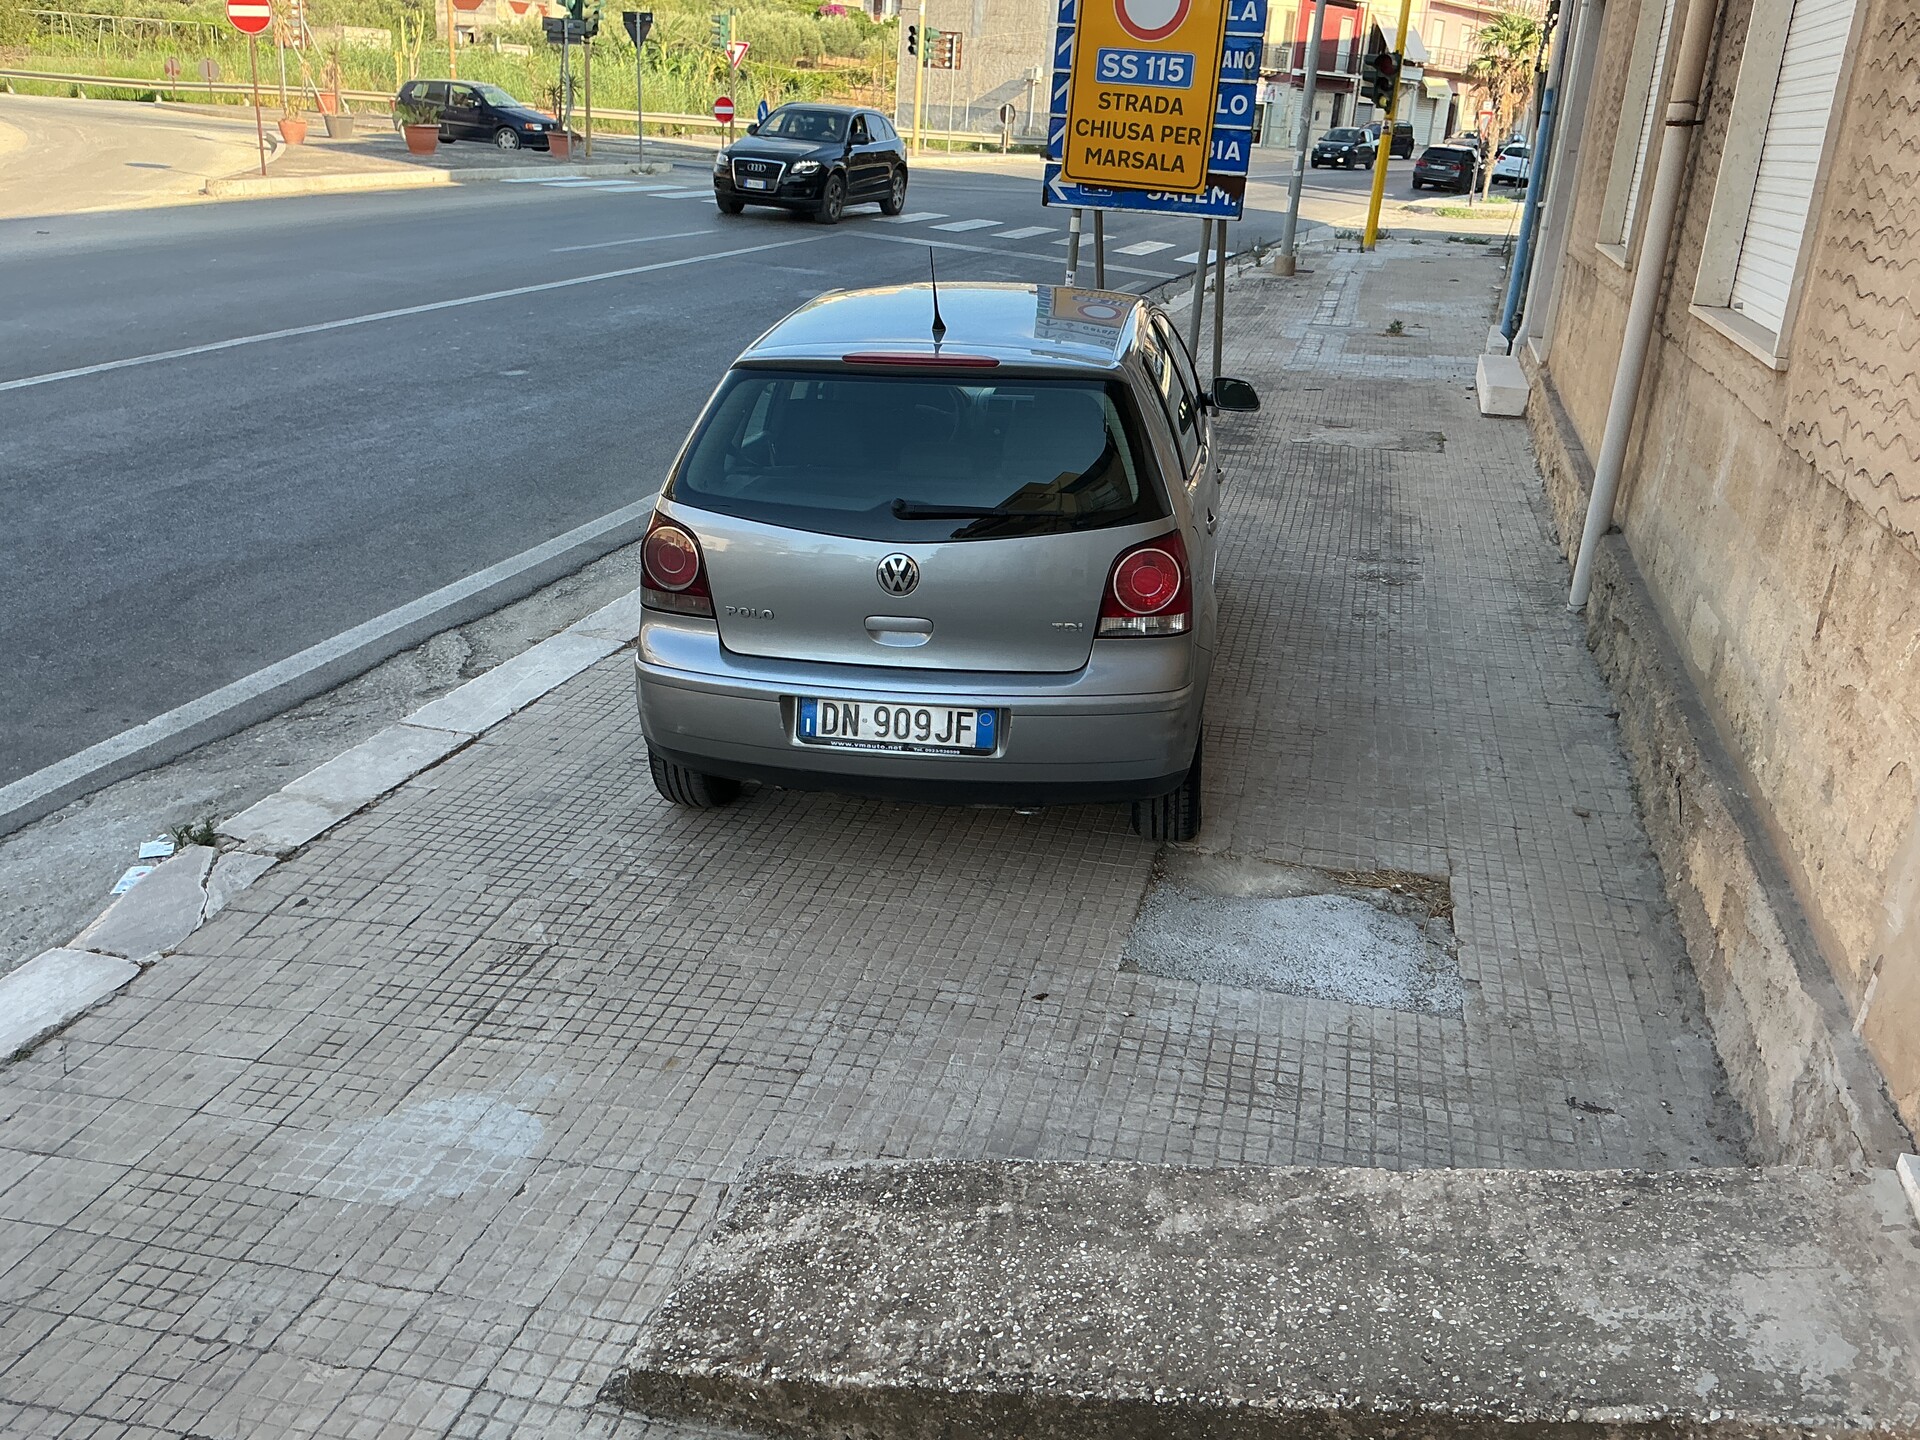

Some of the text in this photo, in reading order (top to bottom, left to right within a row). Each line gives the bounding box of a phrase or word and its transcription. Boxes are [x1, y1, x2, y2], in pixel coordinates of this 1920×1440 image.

[1101, 53, 1184, 82] SS 115
[1097, 91, 1184, 116] STRADA
[1075, 118, 1202, 146] CHIUSA PER
[1084, 147, 1185, 173] MARSALA
[725, 605, 775, 621] POLO
[1051, 622, 1083, 632] TDI
[821, 702, 861, 737] DN
[830, 740, 902, 751] www.vmauto.net
